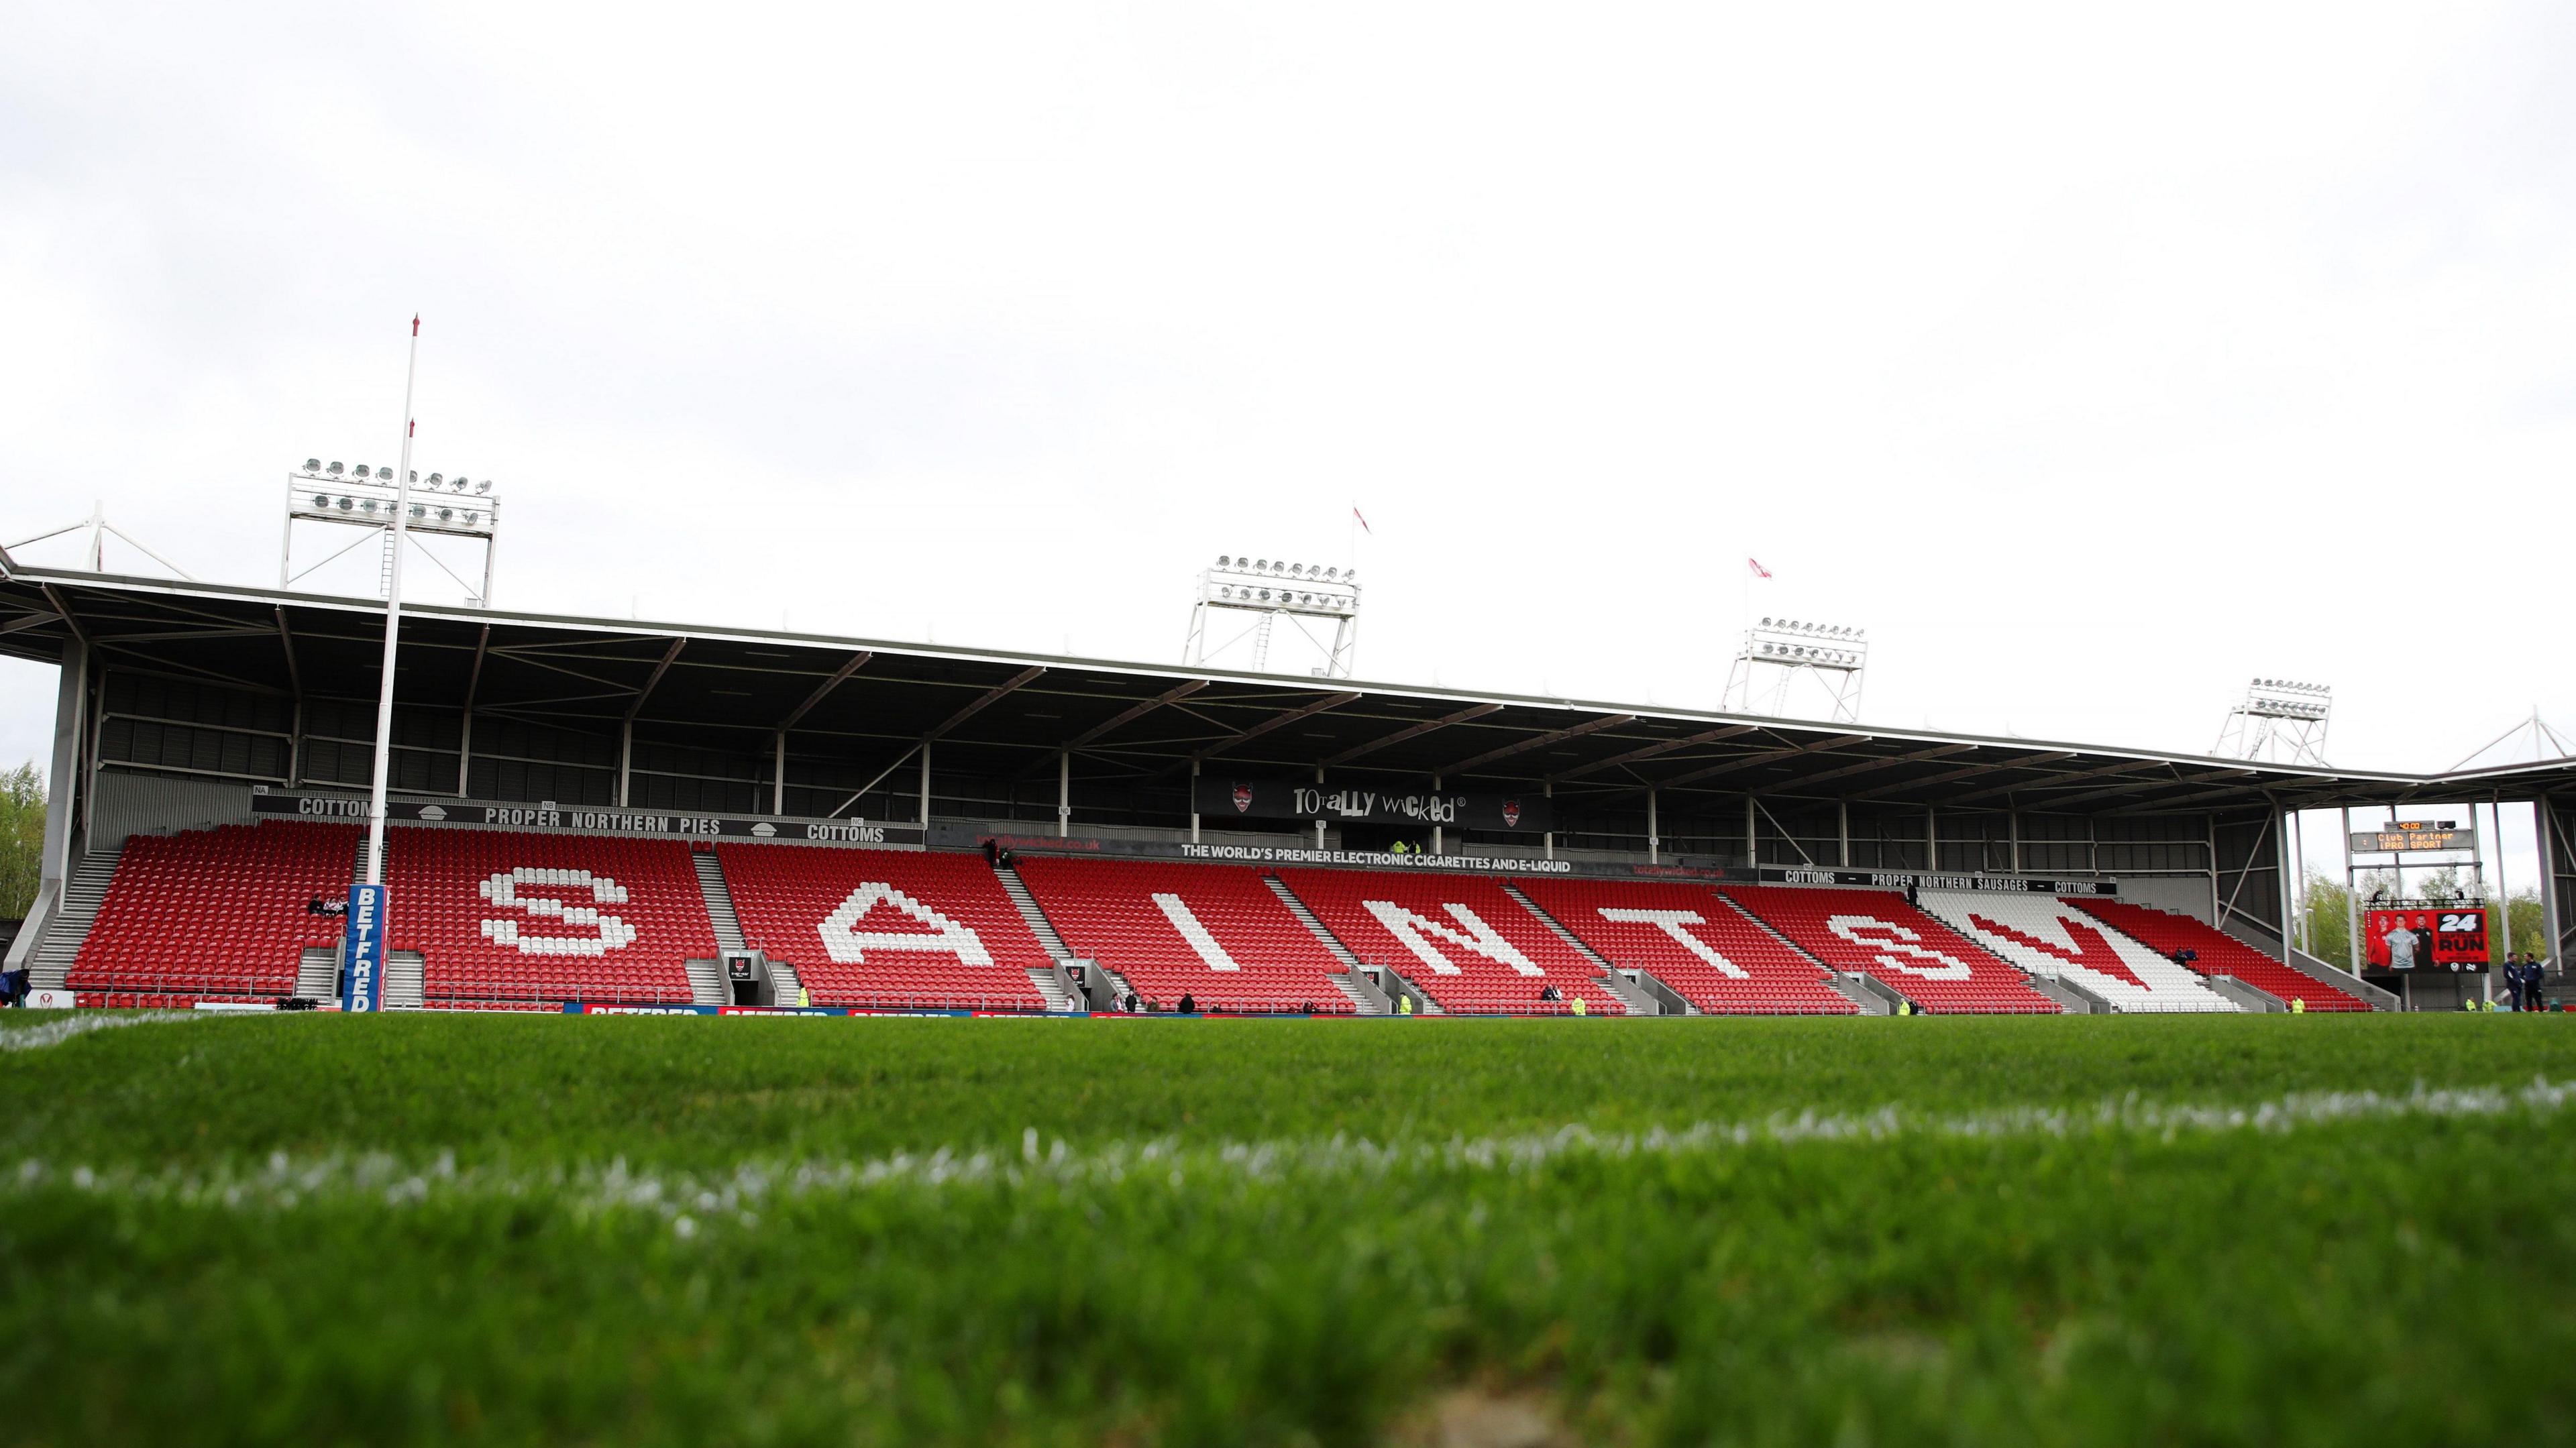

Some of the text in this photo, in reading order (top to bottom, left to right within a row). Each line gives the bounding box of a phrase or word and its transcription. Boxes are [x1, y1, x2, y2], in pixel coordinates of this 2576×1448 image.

[486, 808, 720, 834] PROPER NORTHERN PIES
[853, 818, 862, 826] NC
[808, 824, 884, 842] COTTOMS
[2377, 832, 2453, 842] Club Partner
[2410, 840, 2442, 848] SPORT
[1181, 844, 1209, 857] THE
[1276, 849, 1331, 863] PREMIER
[1334, 851, 1413, 867] ELECTRONIC
[1415, 855, 1490, 869] CIGARETTES
[1492, 858, 1517, 870] AND
[1519, 860, 1570, 873] E-LIQUID
[1785, 871, 1835, 884] COTTOMS
[1872, 874, 1913, 887] PROPER
[1919, 876, 1972, 889] NORTHERN
[1978, 879, 2028, 891] SAUSAGES
[2055, 881, 2096, 894] COTTOMS
[2439, 914, 2477, 932] 24
[351, 888, 376, 1012] BETFRED
[2439, 940, 2484, 951] RUN
